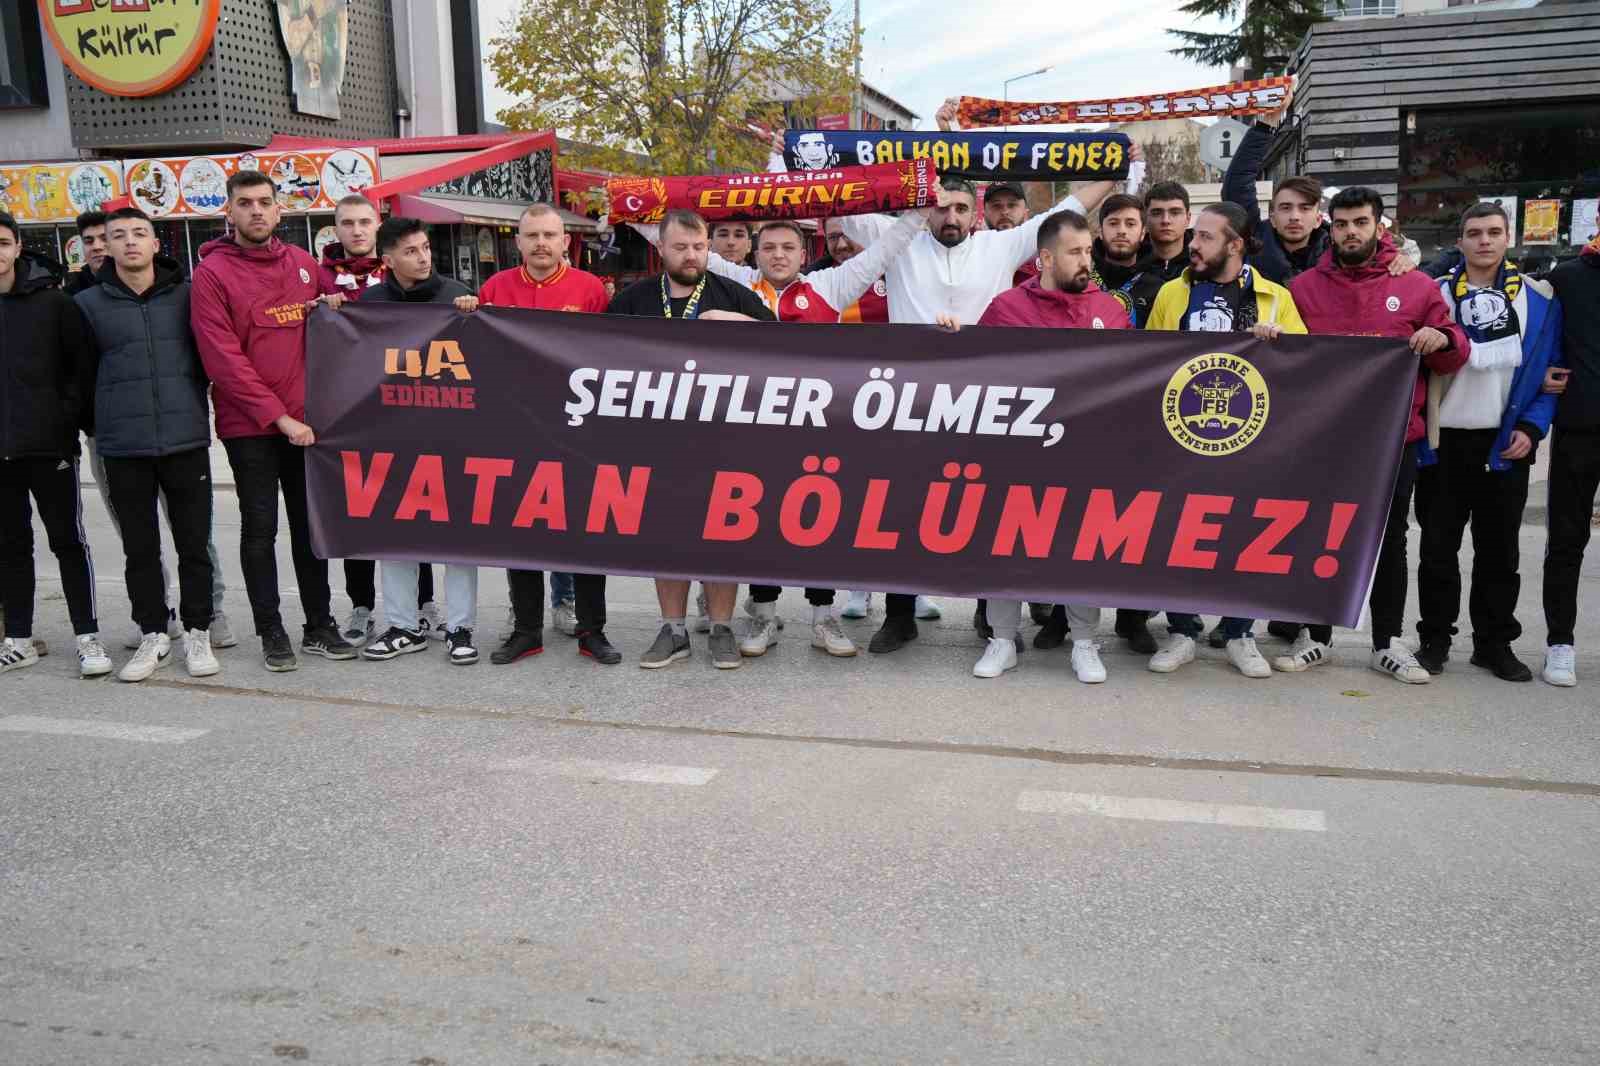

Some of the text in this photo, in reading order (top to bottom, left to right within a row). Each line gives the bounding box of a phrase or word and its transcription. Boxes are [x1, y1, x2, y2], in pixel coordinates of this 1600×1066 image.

[77, 23, 176, 59] Kültür
[856, 139, 1122, 170] BALKAN OF FENER
[699, 181, 869, 208] EDİRNE
[1188, 356, 1250, 376] EDİRNE
[380, 380, 476, 409] EDİRNE
[564, 359, 1065, 447] ŞEHİTLER ÖLMEZ,
[1203, 400, 1228, 414] FB
[342, 451, 1358, 578] VATAN BÖLÜNMEZ!
